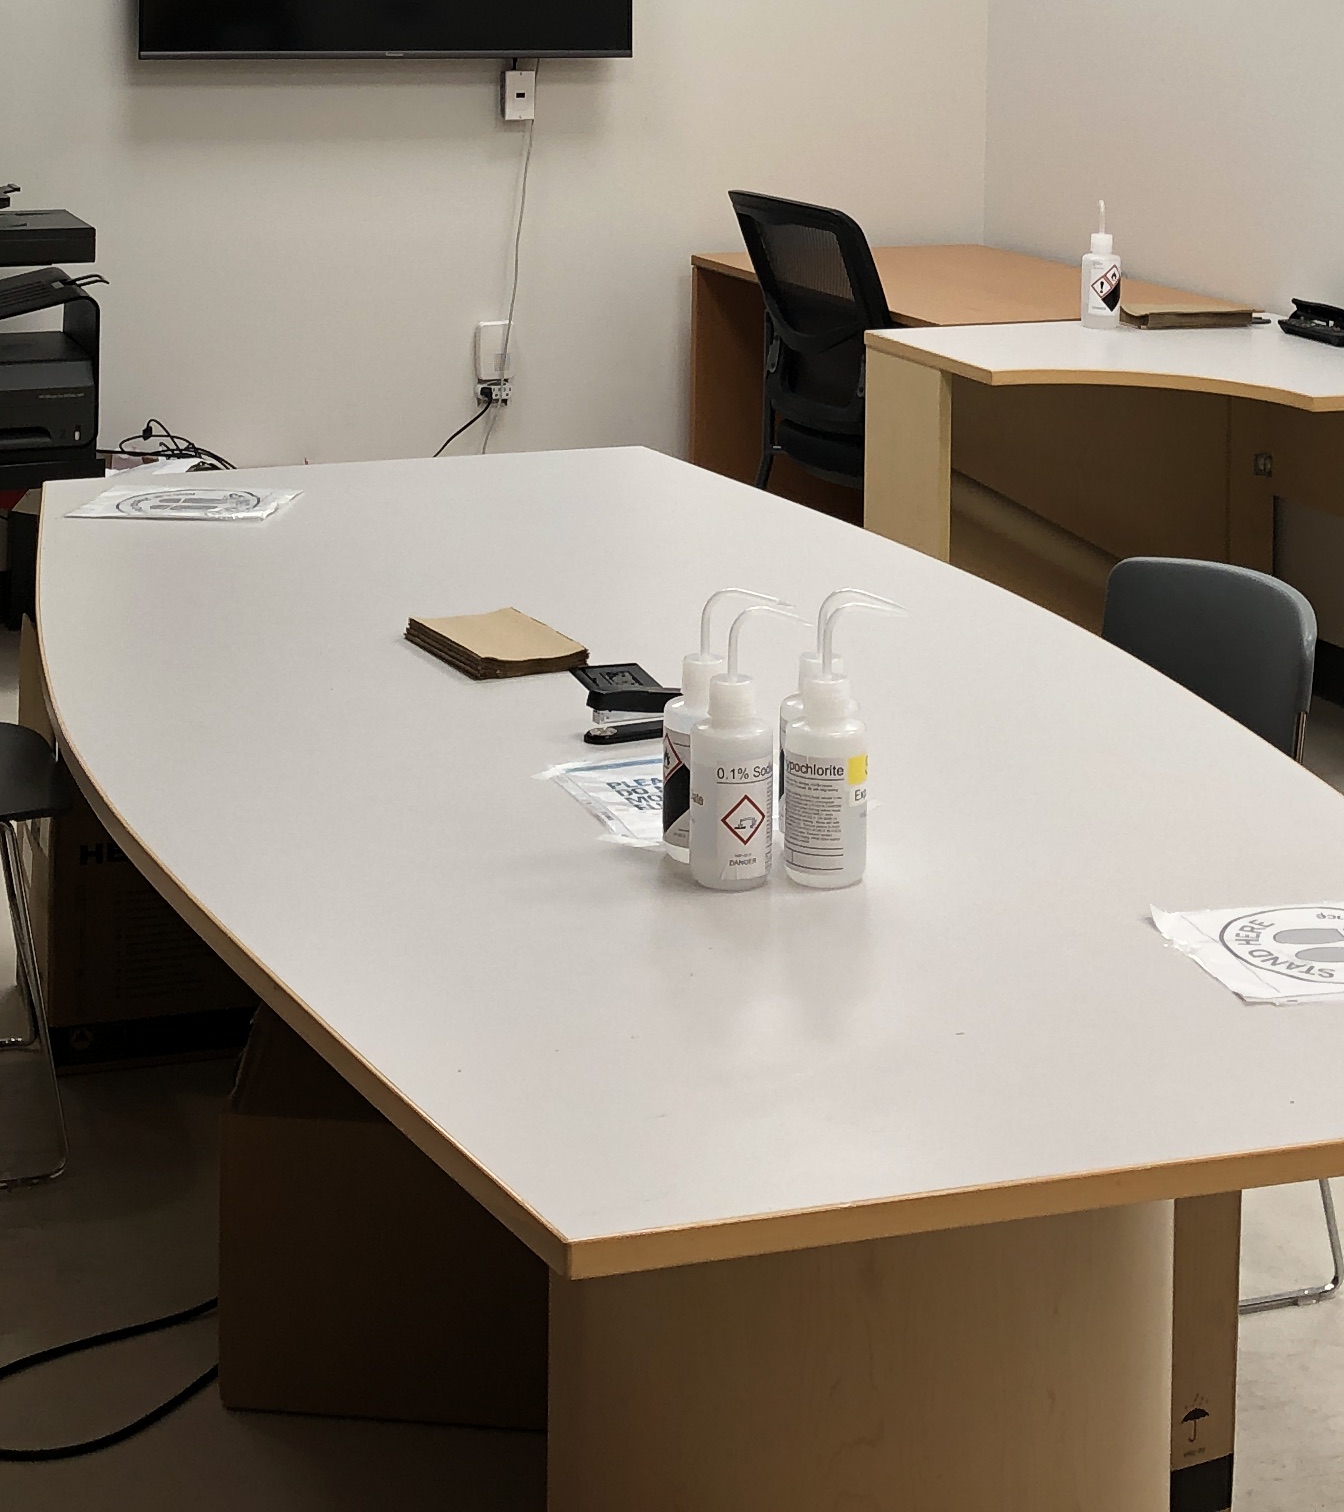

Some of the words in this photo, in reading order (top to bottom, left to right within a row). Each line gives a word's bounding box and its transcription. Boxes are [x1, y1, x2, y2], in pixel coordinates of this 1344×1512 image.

[717, 767, 750, 780] 0.1%
[1234, 919, 1275, 946] HERE
[1248, 948, 1336, 979] STAND
